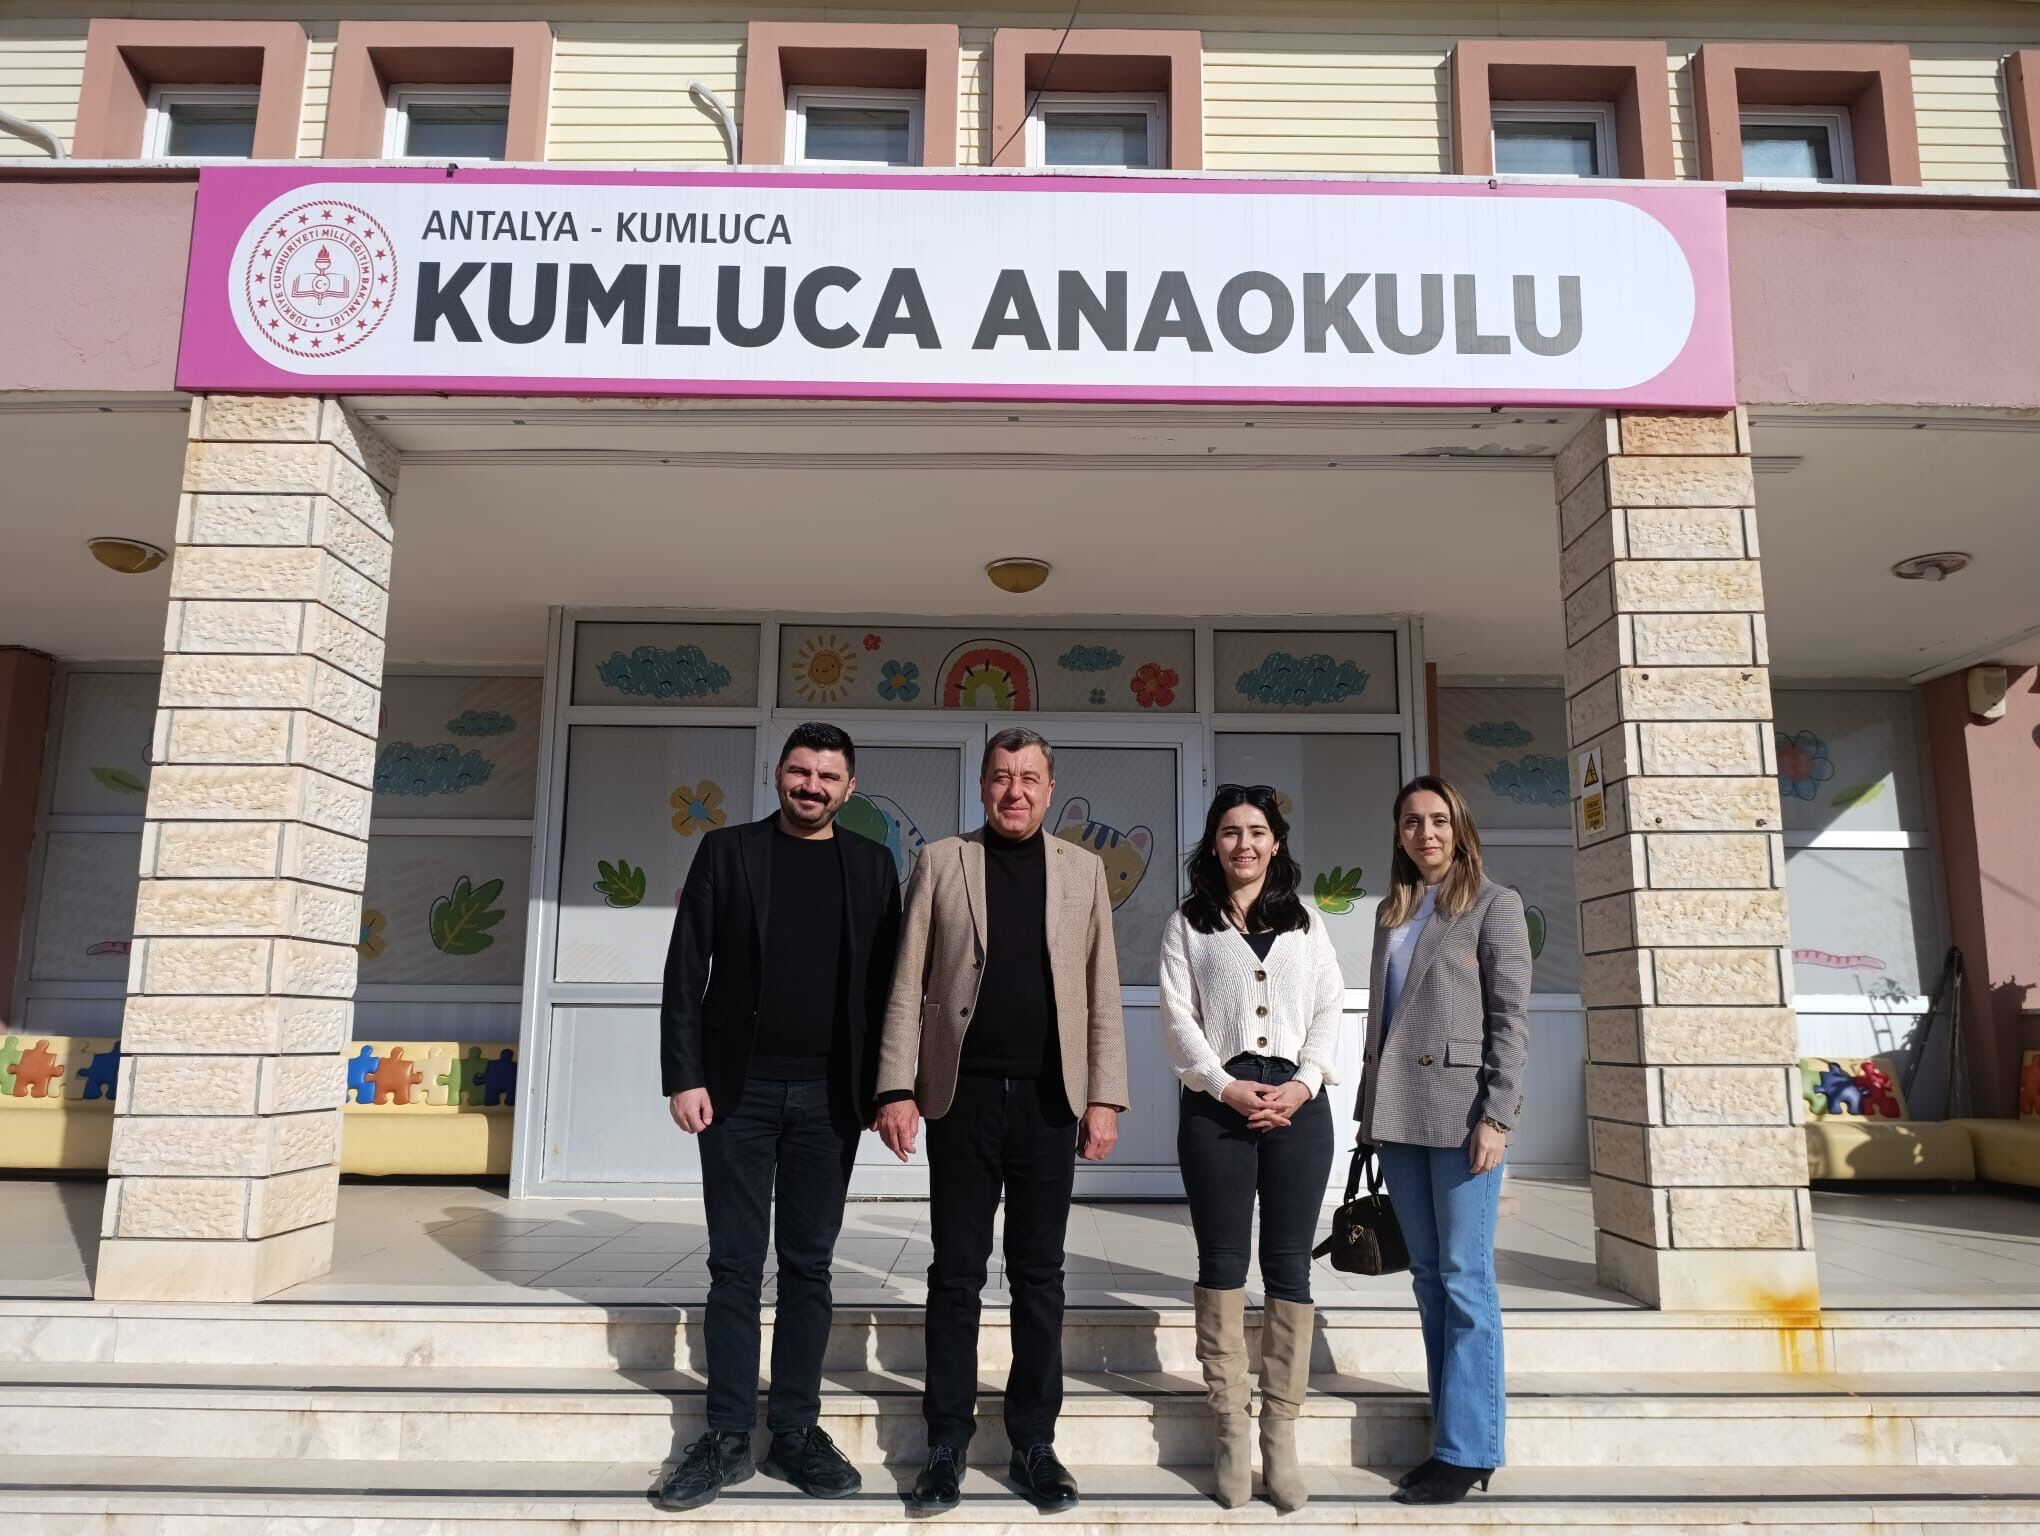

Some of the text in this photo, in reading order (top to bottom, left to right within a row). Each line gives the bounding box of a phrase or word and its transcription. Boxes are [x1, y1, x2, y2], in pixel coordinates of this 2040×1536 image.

[422, 210, 579, 243] ANTALYA
[616, 211, 792, 245] KUMLUCA
[273, 228, 320, 289] CUMHURİYETİ
[348, 240, 371, 275] EĞİTİM
[275, 291, 308, 327] TÜRKİYE
[330, 277, 370, 327] BAKANLIĞI
[413, 262, 1583, 357] KUMLUCA ANAOKULU
